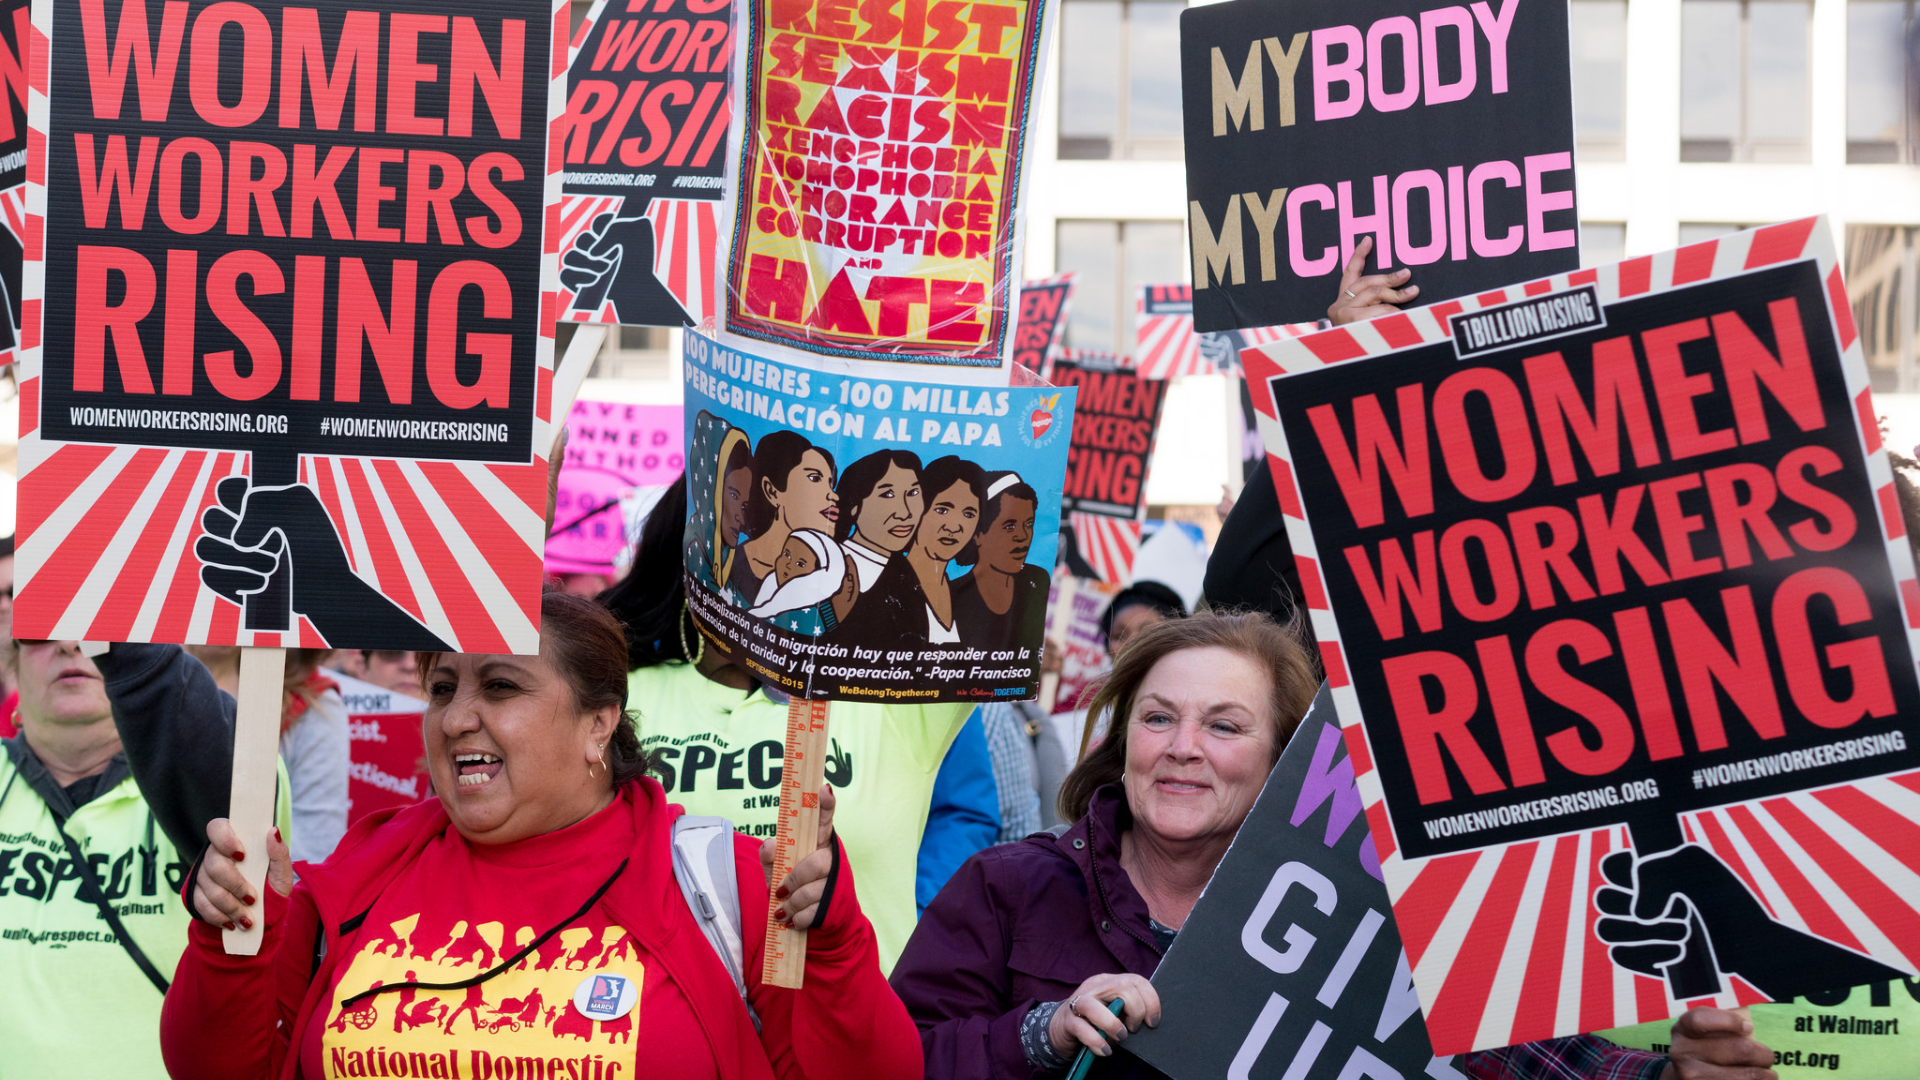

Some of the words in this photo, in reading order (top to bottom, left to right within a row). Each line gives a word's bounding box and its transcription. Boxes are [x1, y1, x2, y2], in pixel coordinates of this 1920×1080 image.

[770, 0, 1018, 54] RESIST
[80, 0, 526, 140] WOMEN
[766, 32, 1014, 103] SEXISM
[765, 78, 1007, 149] RACISM
[760, 151, 995, 202] HOMOPHOBIA
[765, 123, 998, 176] XENOPHOBIA
[73, 133, 525, 249] WORKERS
[757, 176, 994, 231] IGNORANCE
[756, 206, 992, 262] CORRUPTION
[843, 256, 883, 271] AND
[745, 253, 987, 343] HATE
[1537, 291, 1595, 332] RISING
[73, 244, 514, 410] RISING
[685, 331, 708, 365] 100
[712, 346, 811, 399] MUJERES
[839, 379, 893, 411] 100
[902, 386, 1010, 417] MILLAS
[69, 406, 288, 435] WOMENWORKERSRISING.ORG
[320, 417, 509, 443] #WOMENWORKERSRISING
[685, 360, 865, 439] PEREGRINACIÓN
[873, 417, 912, 442] AL
[921, 419, 1002, 447] PAPA
[1306, 297, 1827, 529] WOMEN
[1343, 445, 1858, 642] WORKERS
[728, 628, 740, 642] de
[740, 633, 749, 649] la
[750, 642, 788, 667] caridad
[787, 660, 798, 673] y
[801, 659, 815, 675] la
[969, 665, 1032, 680] Francisco
[752, 622, 765, 637] de
[766, 628, 777, 644] la
[778, 636, 848, 657] migración
[853, 645, 883, 664] hay
[886, 649, 915, 667] que
[917, 647, 988, 664] responder
[990, 650, 1015, 661] con
[1018, 646, 1030, 660] la
[745, 657, 780, 683] SEPTIEMBRE
[781, 676, 805, 691] 2015
[839, 685, 940, 698] WeBelongTogether.org
[1381, 566, 1898, 806] RISING
[713, 734, 730, 749] for
[743, 795, 757, 809] at
[1423, 777, 1660, 840] WOMENWORKERSRISING.ORG
[1691, 729, 1907, 790] #WOMENWORKERSRISING
[590, 1002, 615, 1011] MARCH
[1794, 1015, 1814, 1033] at
[1818, 1014, 1900, 1036] Walmart
[331, 1046, 461, 1080] National
[470, 1053, 623, 1080] Domestic
